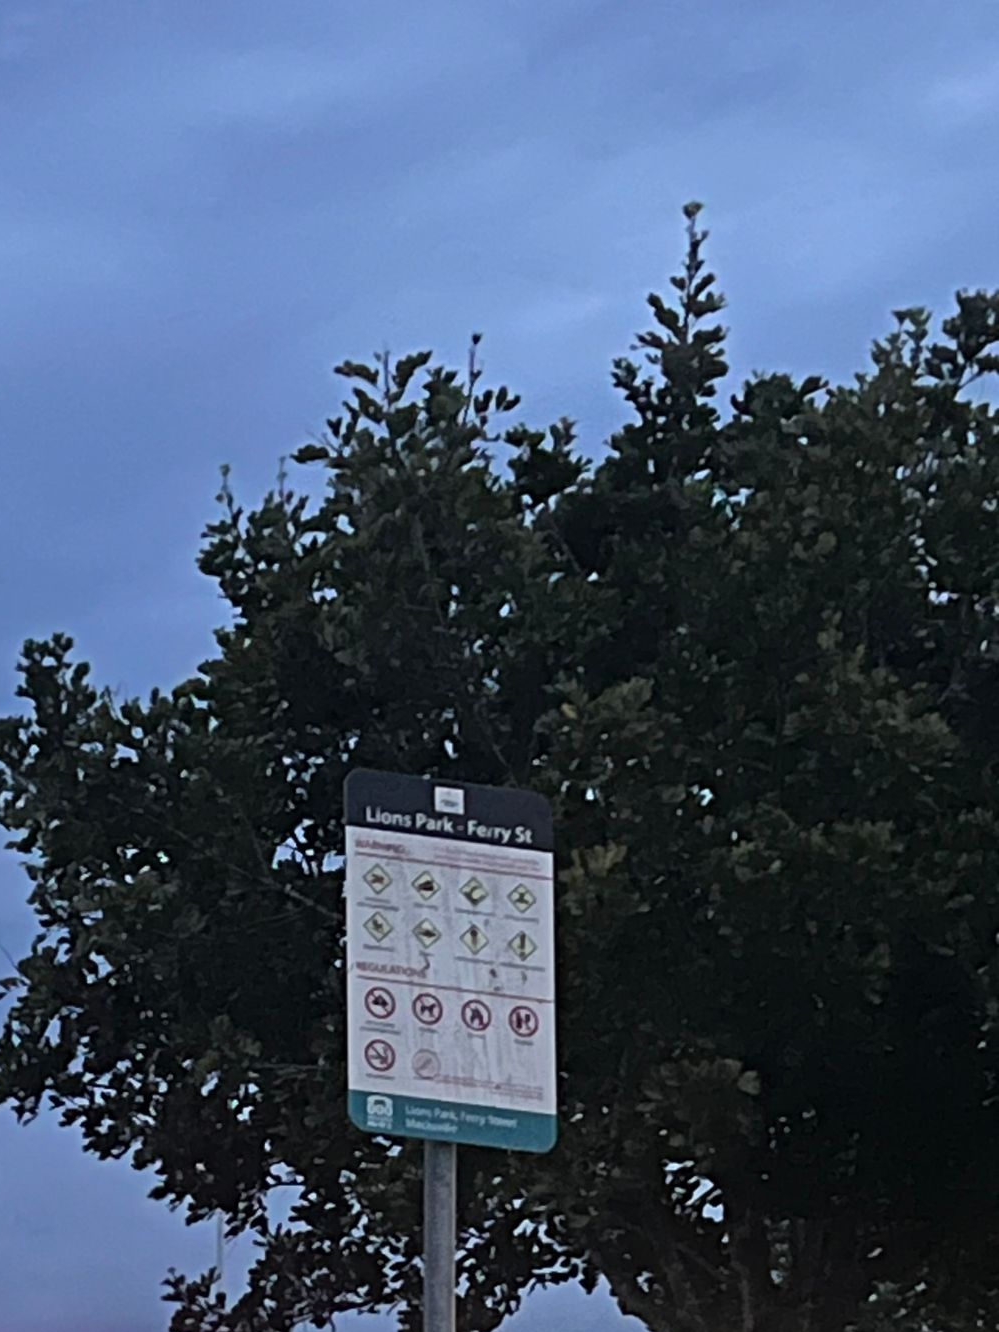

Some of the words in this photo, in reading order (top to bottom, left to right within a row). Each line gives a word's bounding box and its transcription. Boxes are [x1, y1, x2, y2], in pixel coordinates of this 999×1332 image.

[366, 806, 411, 827] Lions
[416, 813, 454, 833] Park
[467, 820, 511, 844] Ferry
[515, 826, 532, 843] St
